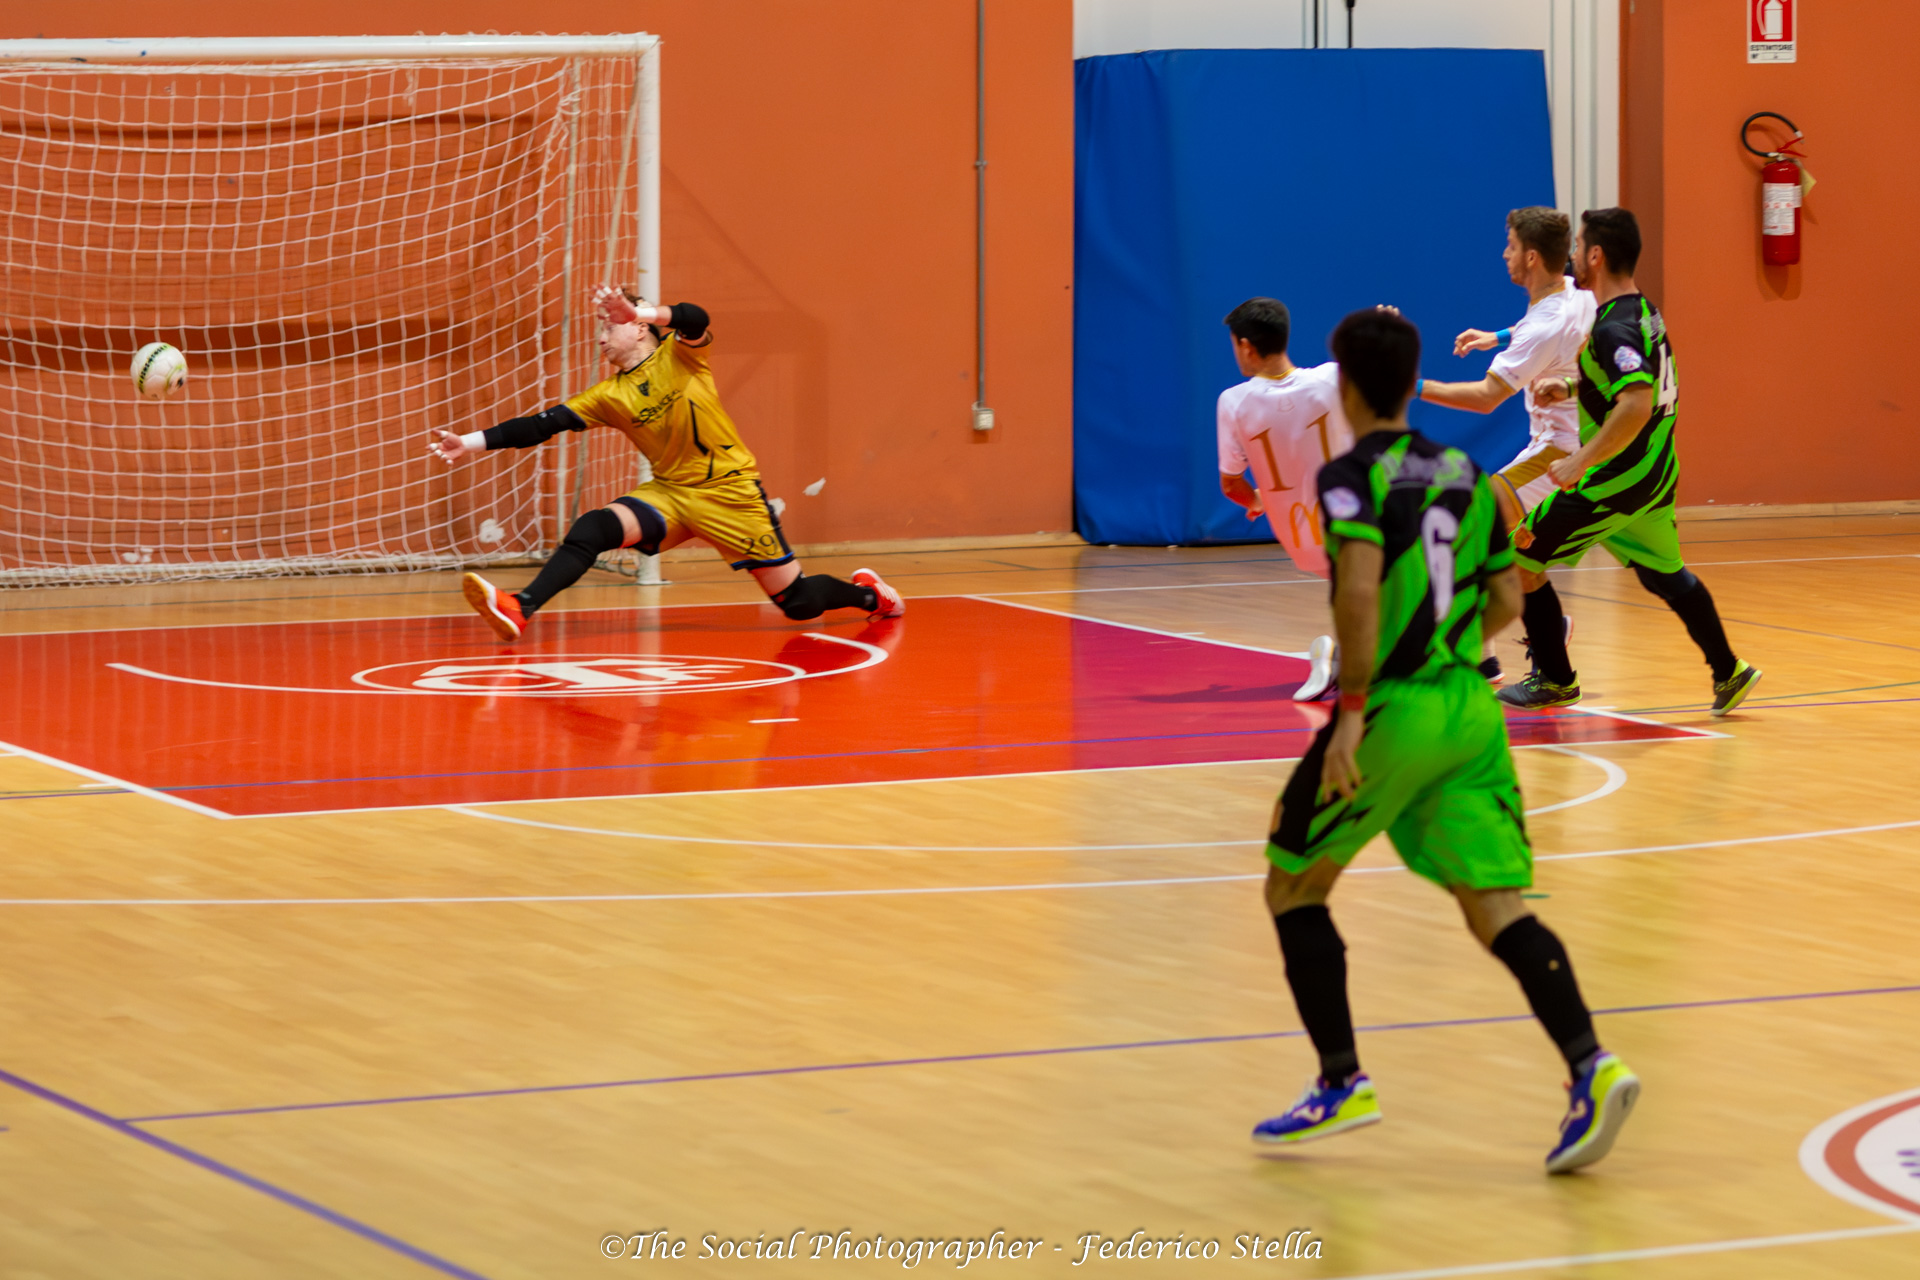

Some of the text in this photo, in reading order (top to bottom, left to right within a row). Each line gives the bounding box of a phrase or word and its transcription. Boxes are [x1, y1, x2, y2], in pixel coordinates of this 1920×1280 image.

[1657, 343, 1677, 416] 4
[1249, 412, 1331, 492] 11
[1421, 506, 1459, 624] 6
